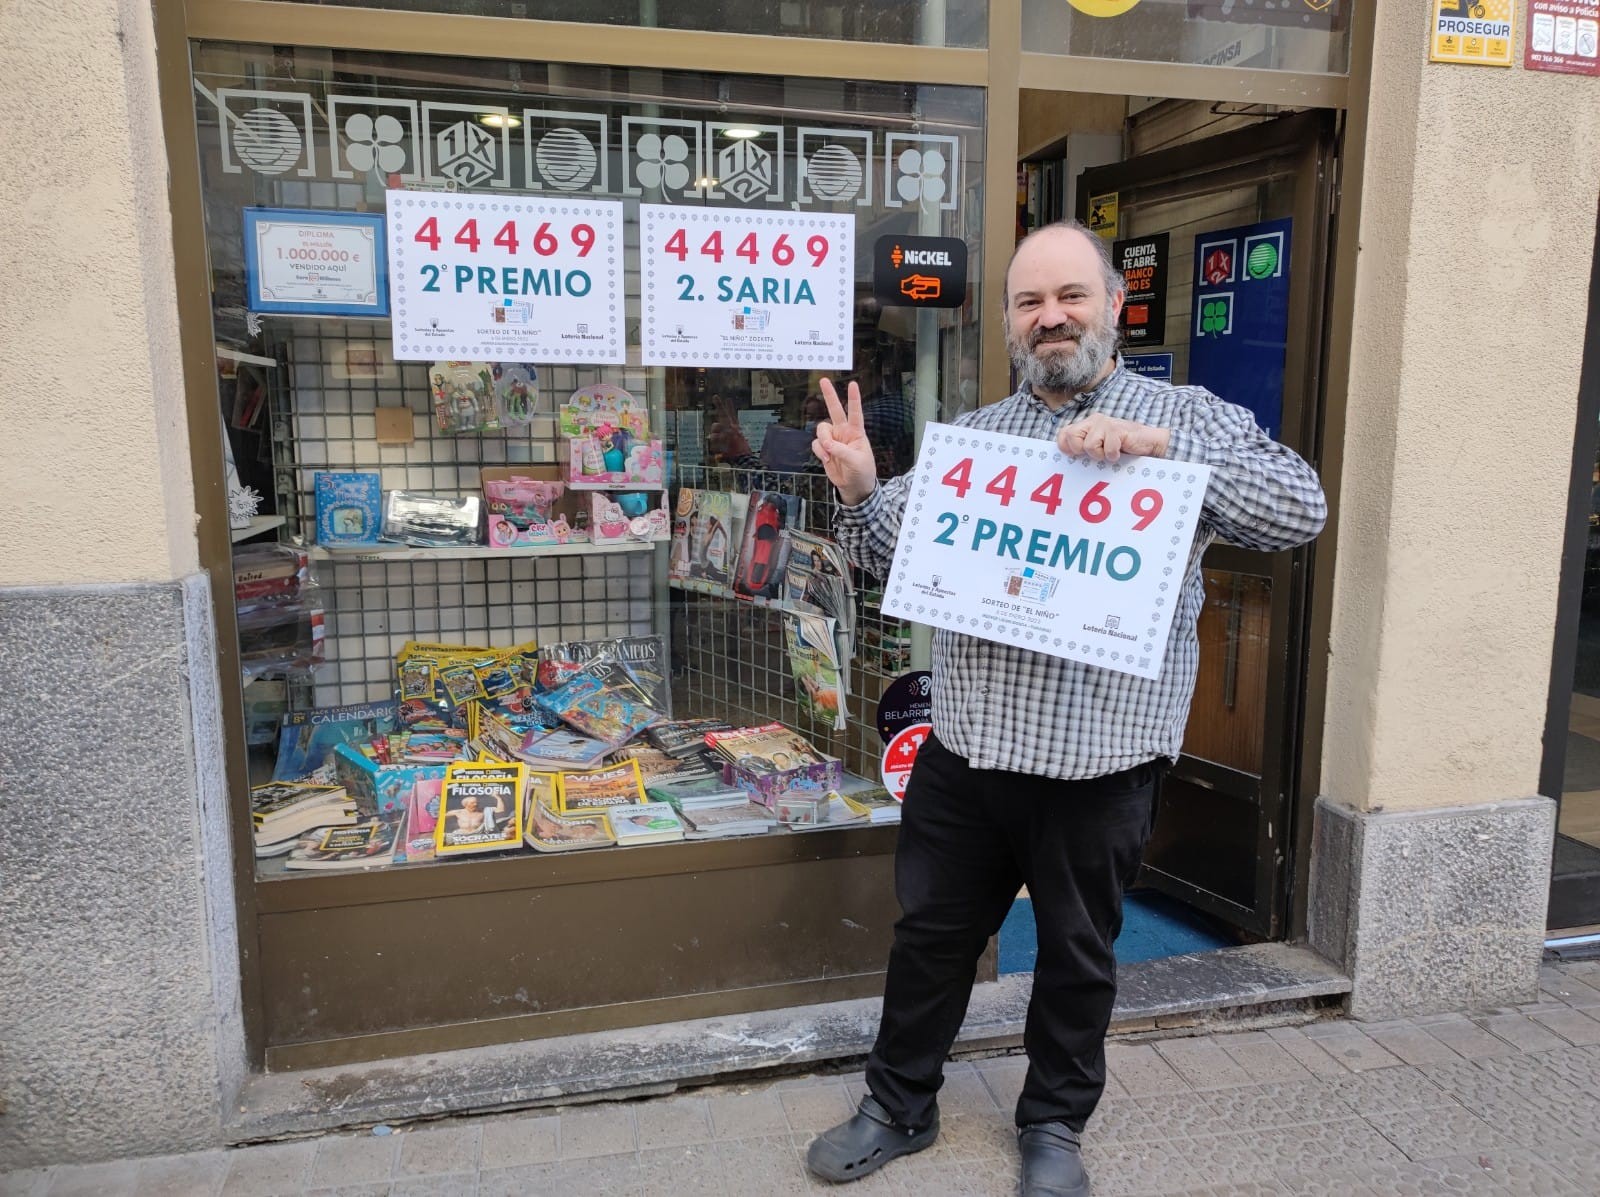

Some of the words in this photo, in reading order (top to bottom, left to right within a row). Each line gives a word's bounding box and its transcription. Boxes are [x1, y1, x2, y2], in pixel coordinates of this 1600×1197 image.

[1438, 19, 1510, 36] PROSEGUR
[298, 230, 335, 239] DIPLOMA
[277, 248, 349, 262] 1.000.000
[352, 254, 360, 263] €
[1124, 244, 1157, 258] CUENTA
[289, 263, 326, 271] VENDIDO
[1122, 259, 1132, 269] TE
[1133, 255, 1157, 268] ABRE,
[1125, 267, 1154, 280] BANCO
[455, 265, 592, 298] PREMIO
[1127, 280, 1139, 291] NO
[1140, 280, 1151, 290] ES
[677, 274, 705, 302] 2.
[717, 275, 816, 306] SARIA
[971, 518, 1141, 581] PREMIO
[981, 597, 1009, 610] SORTEO
[1011, 604, 1021, 612] DE
[1108, 629, 1138, 642] Nacional
[885, 708, 931, 721] BELARRIP
[575, 768, 627, 781] VIAJES
[452, 786, 511, 796] FILOSOFÍA
